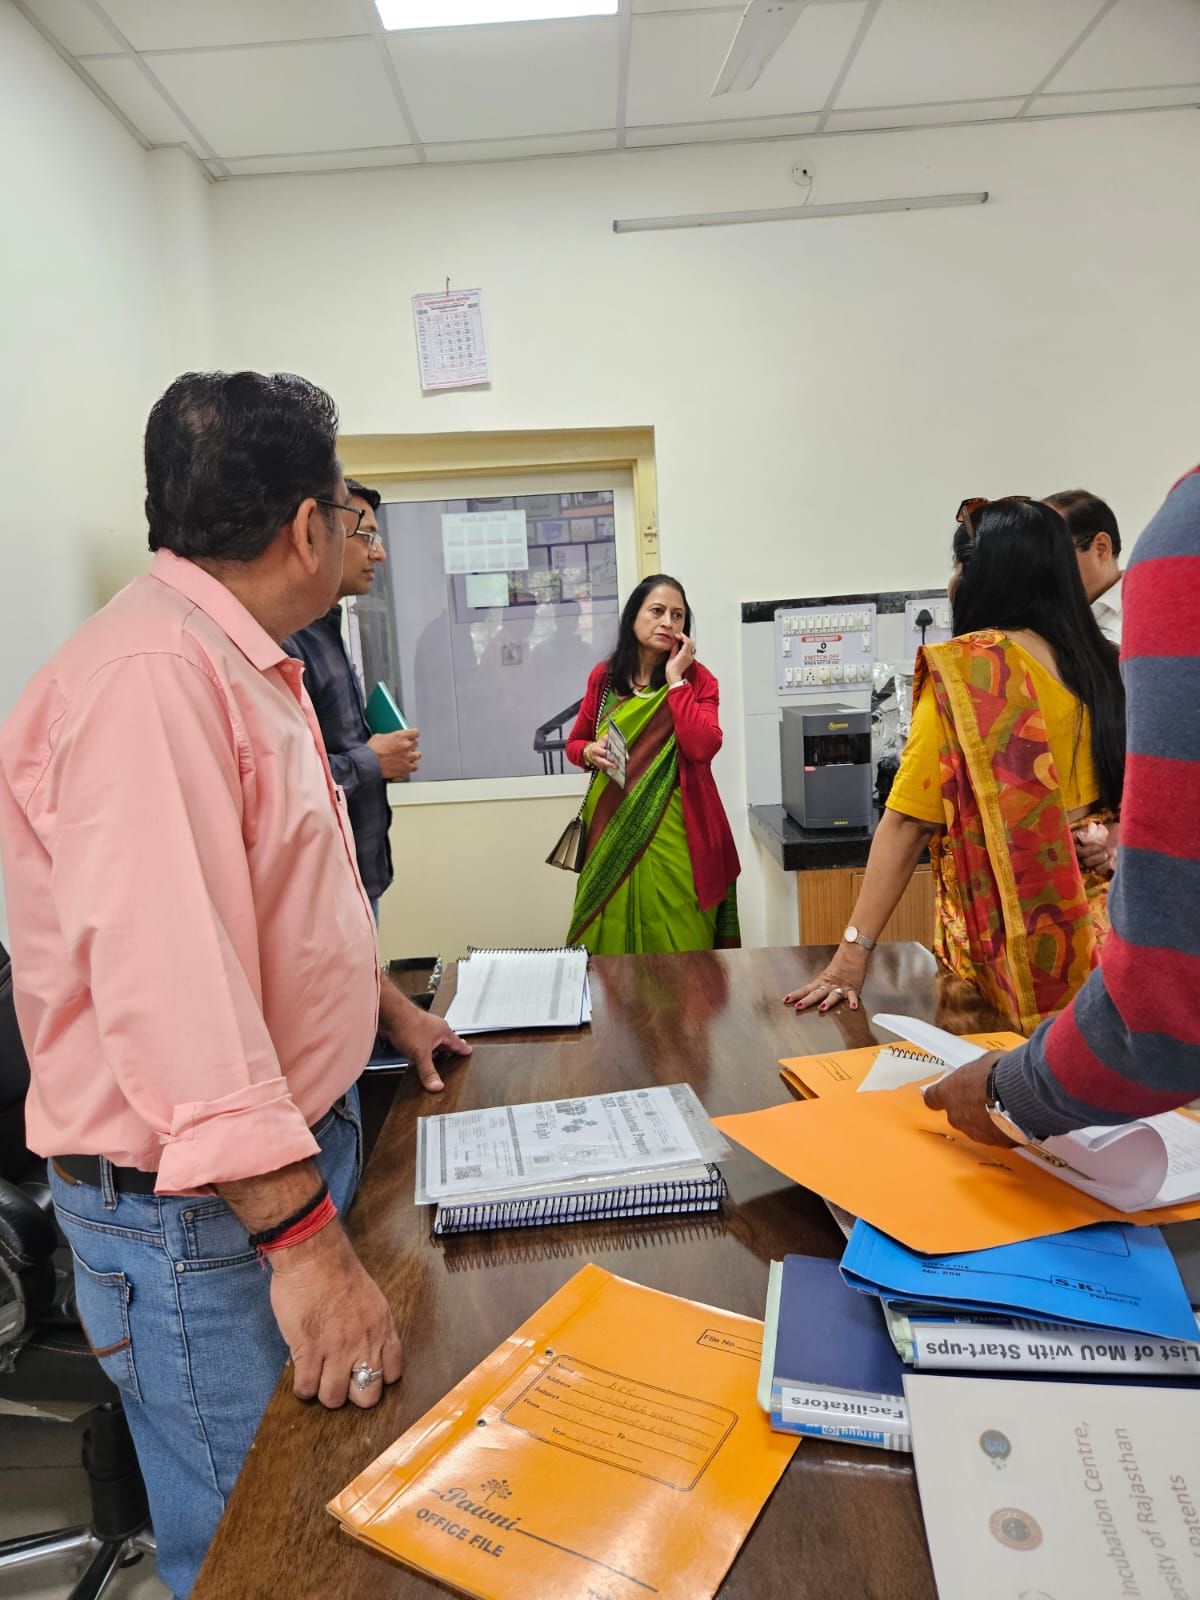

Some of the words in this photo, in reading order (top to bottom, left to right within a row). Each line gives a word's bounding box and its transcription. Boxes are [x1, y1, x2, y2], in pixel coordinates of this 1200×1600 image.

[703, 1334, 720, 1343] File
[926, 1339, 1020, 1360] Start-ups
[1027, 1344, 1073, 1360] with
[1080, 1344, 1126, 1360] MoU
[1134, 1345, 1154, 1361] of
[791, 1397, 904, 1418] Facilitators
[1074, 1422, 1103, 1492] Centre,
[1115, 1428, 1157, 1524] Rajasthan
[416, 1508, 470, 1541] OFFICE
[468, 1534, 505, 1558] FILE
[1141, 1528, 1166, 1548] of
[1094, 1499, 1142, 1596] Incubation
